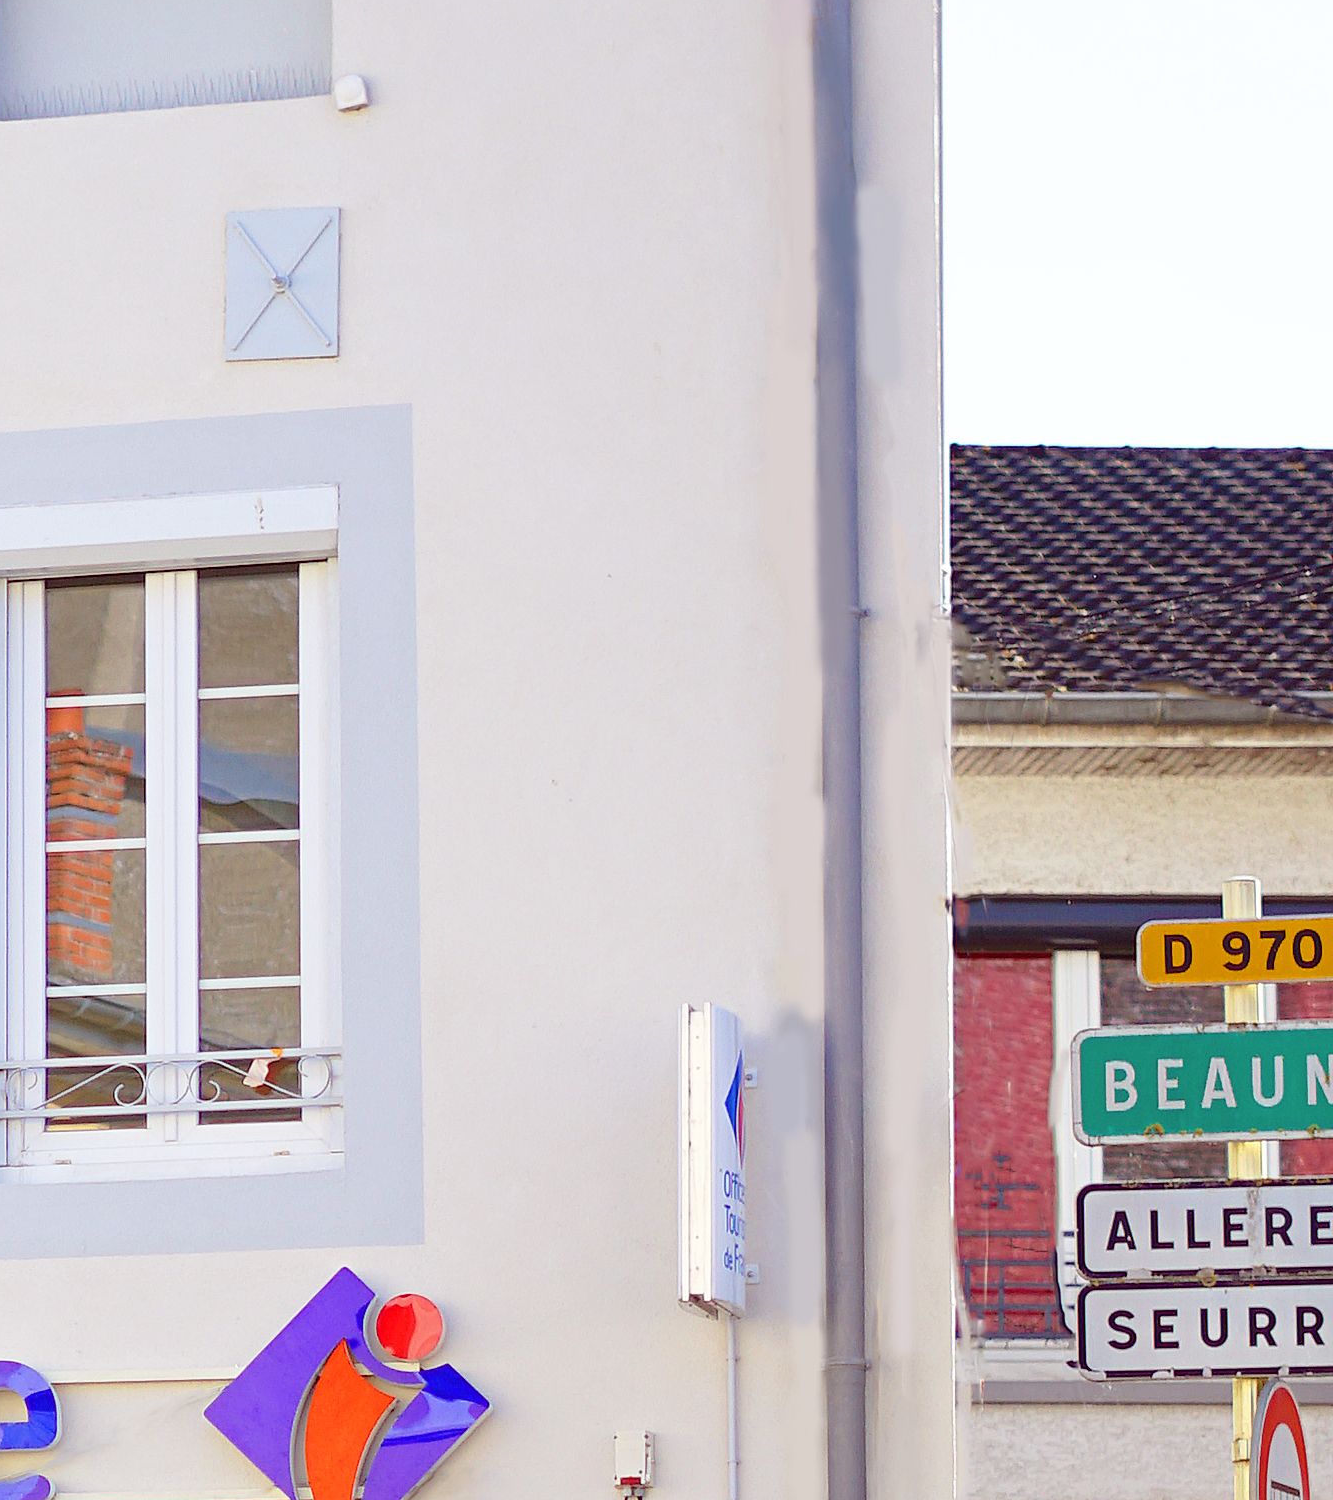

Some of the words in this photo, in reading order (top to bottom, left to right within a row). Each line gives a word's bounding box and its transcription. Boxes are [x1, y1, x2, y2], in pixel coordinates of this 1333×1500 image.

[1163, 934, 1193, 975] D
[1222, 929, 1323, 972] 970
[1106, 1206, 1333, 1251] ALLERE
[1107, 1306, 1325, 1350] SEURR
